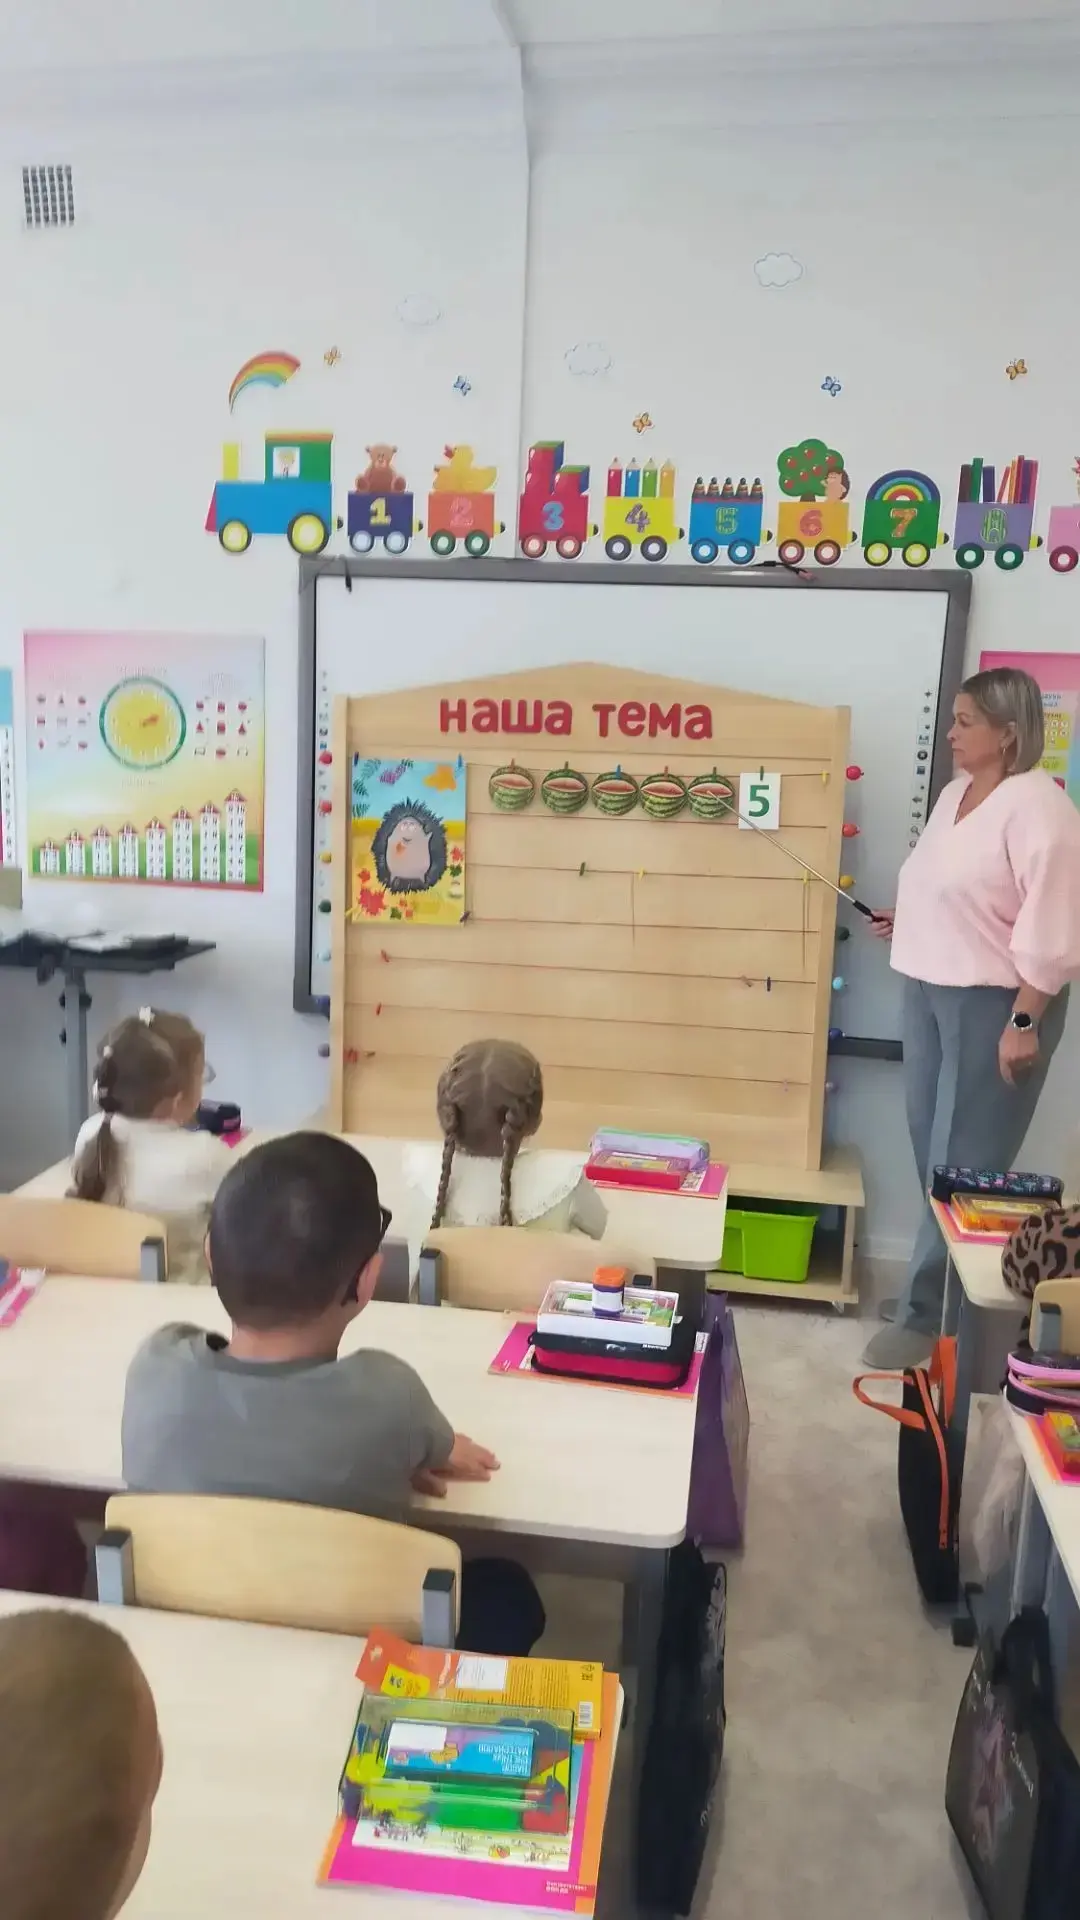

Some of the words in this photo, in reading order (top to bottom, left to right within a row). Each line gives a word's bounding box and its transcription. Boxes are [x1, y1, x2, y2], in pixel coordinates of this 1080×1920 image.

[370, 498, 391, 525] 1
[450, 497, 474, 527] 2
[543, 501, 565, 530] 3
[625, 503, 651, 533] 4
[715, 507, 739, 535] 5
[800, 509, 824, 537] 6
[890, 508, 917, 538] 7
[981, 508, 1006, 544] 8
[440, 698, 573, 736] наша
[592, 701, 713, 740] тема
[748, 784, 770, 817] 5
